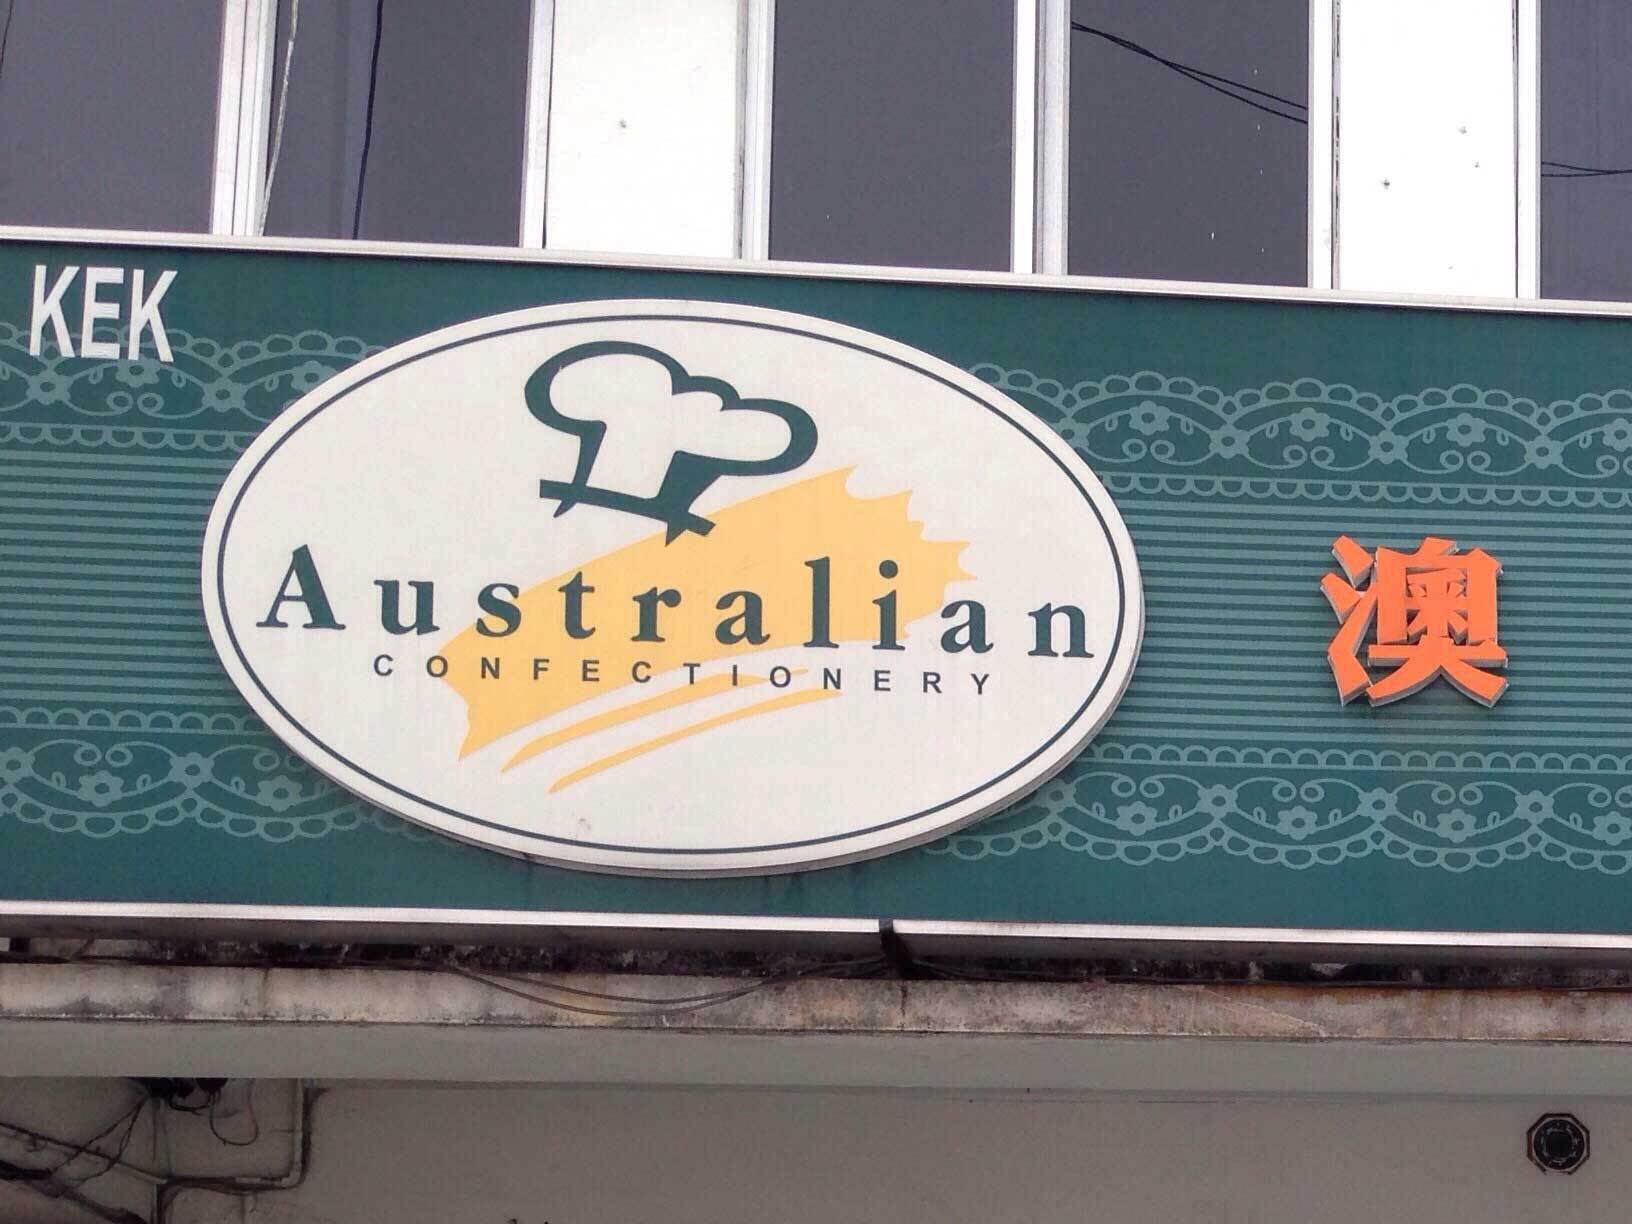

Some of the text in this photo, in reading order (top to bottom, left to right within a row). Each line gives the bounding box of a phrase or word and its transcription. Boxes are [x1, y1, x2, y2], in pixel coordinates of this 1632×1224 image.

[29, 263, 178, 363] KEK
[256, 543, 1095, 659] Australian
[373, 653, 994, 696] CONFECTIONERY
